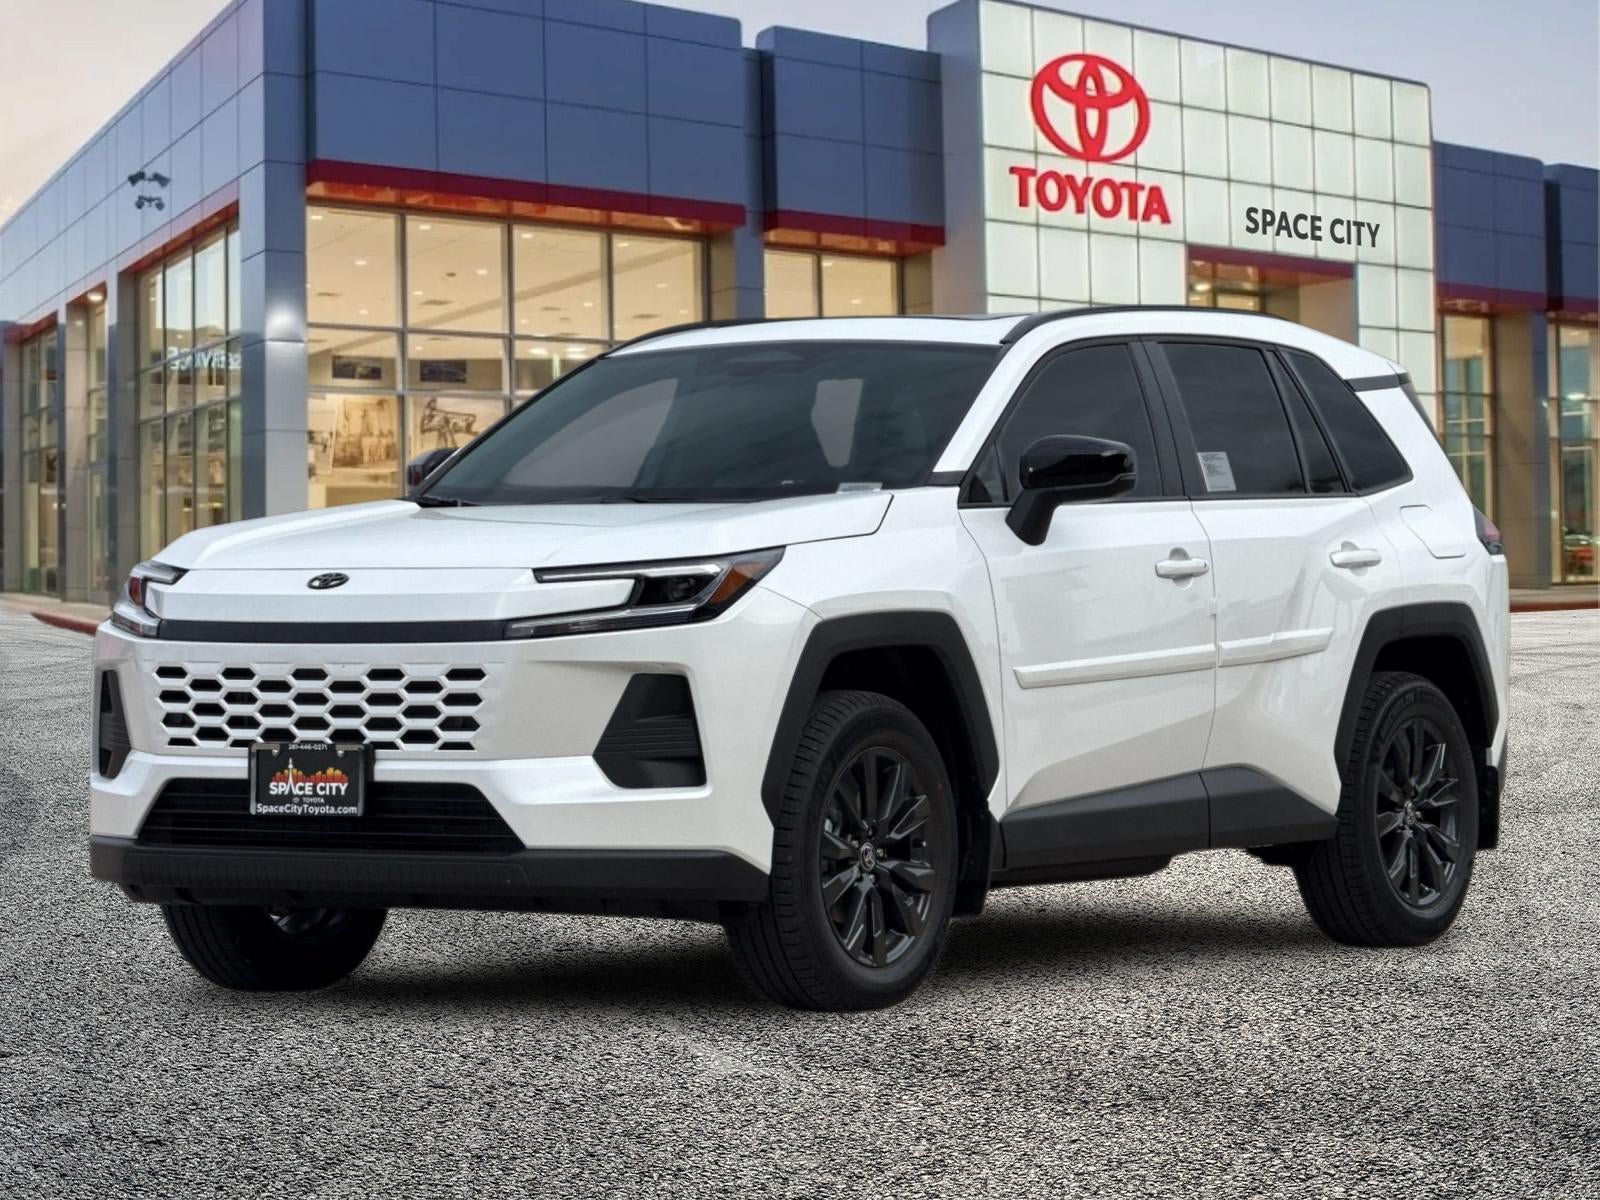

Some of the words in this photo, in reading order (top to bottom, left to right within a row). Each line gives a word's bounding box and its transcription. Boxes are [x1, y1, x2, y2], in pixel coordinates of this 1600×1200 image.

[1009, 167, 1171, 225] TOYOTA
[1245, 206, 1322, 241] SPACE
[1329, 219, 1381, 248] CITY
[269, 781, 313, 795] SPACE
[316, 782, 349, 795] CITY
[256, 803, 358, 815] SpaceCityToyota.com
